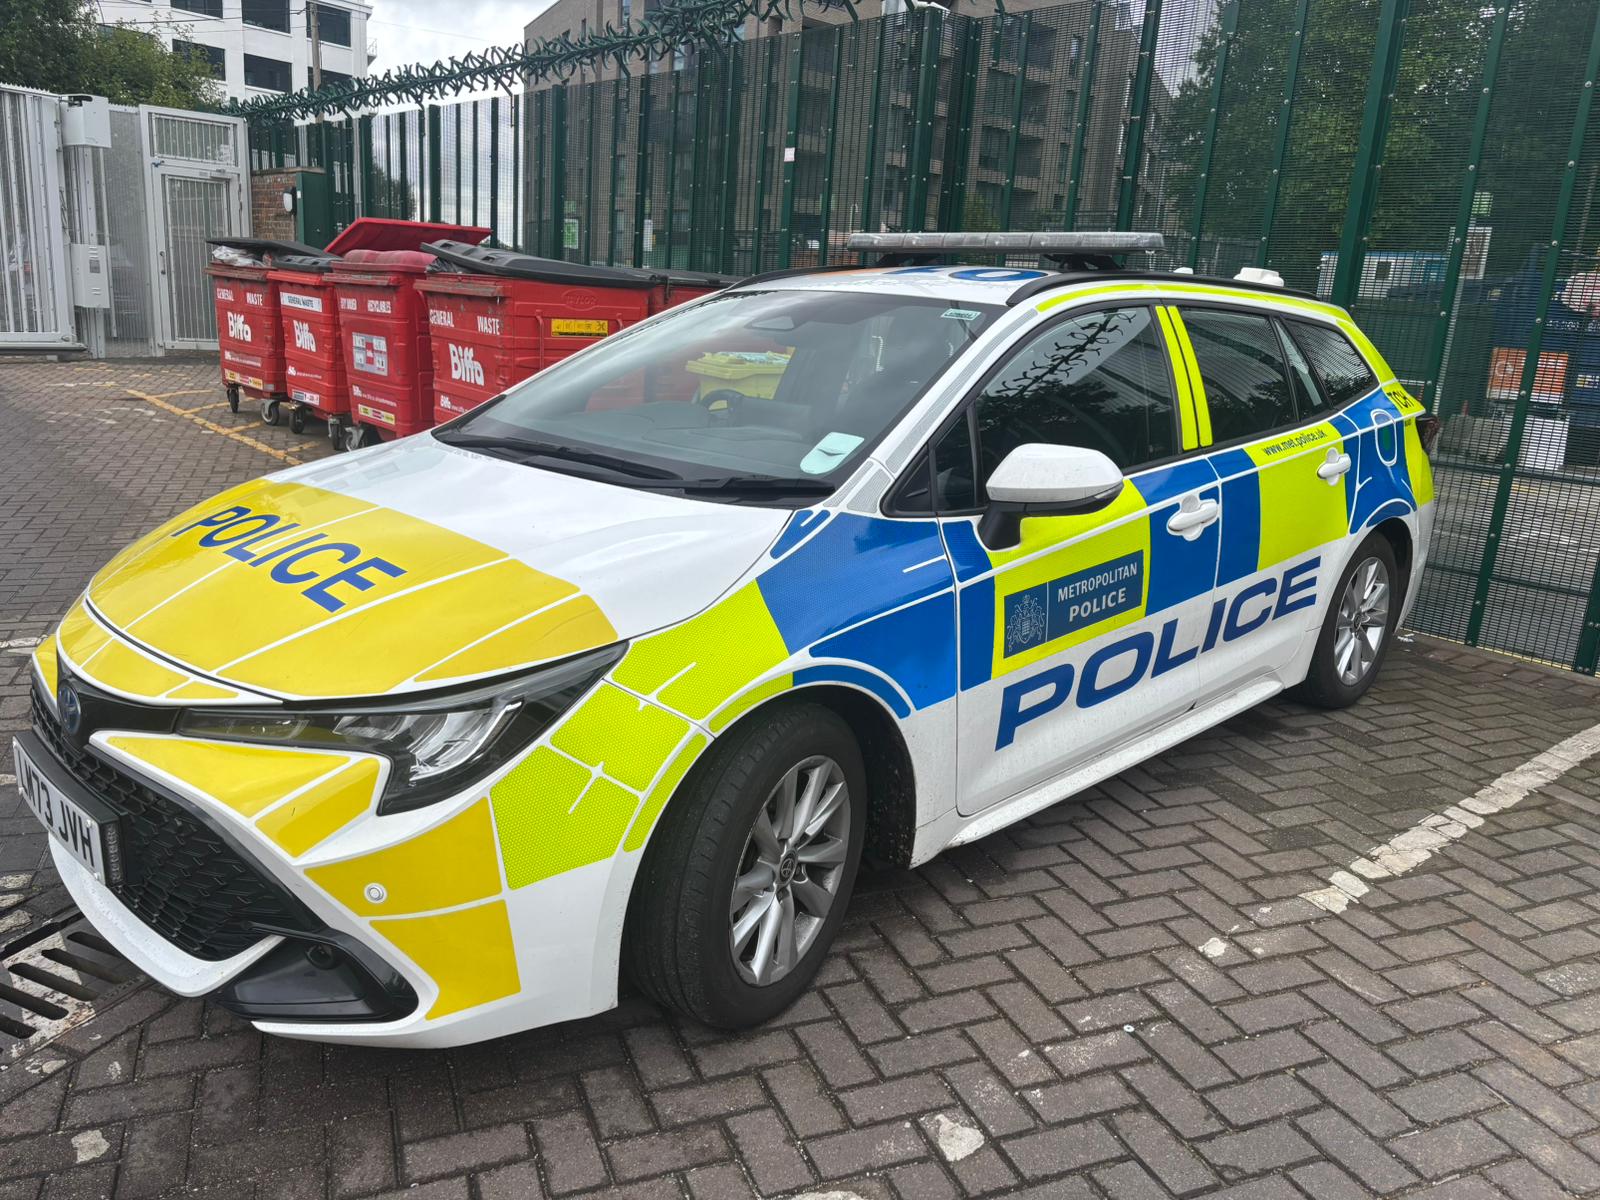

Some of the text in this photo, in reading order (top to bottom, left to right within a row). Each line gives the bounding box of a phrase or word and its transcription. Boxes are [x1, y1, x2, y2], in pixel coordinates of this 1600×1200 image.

[246, 292, 263, 306] WASTE
[227, 311, 252, 342] Biffa
[293, 319, 317, 353] Biffa
[429, 309, 500, 336] GENERAL WASTE
[448, 343, 485, 387] Biffa
[1263, 429, 1328, 456] www.met.police.uk
[170, 505, 409, 613] POLICE
[1057, 562, 1138, 603] METROPOLITAN
[1069, 587, 1127, 622] POLICE
[995, 555, 1321, 752] POLICE
[58, 800, 95, 868] JVH
